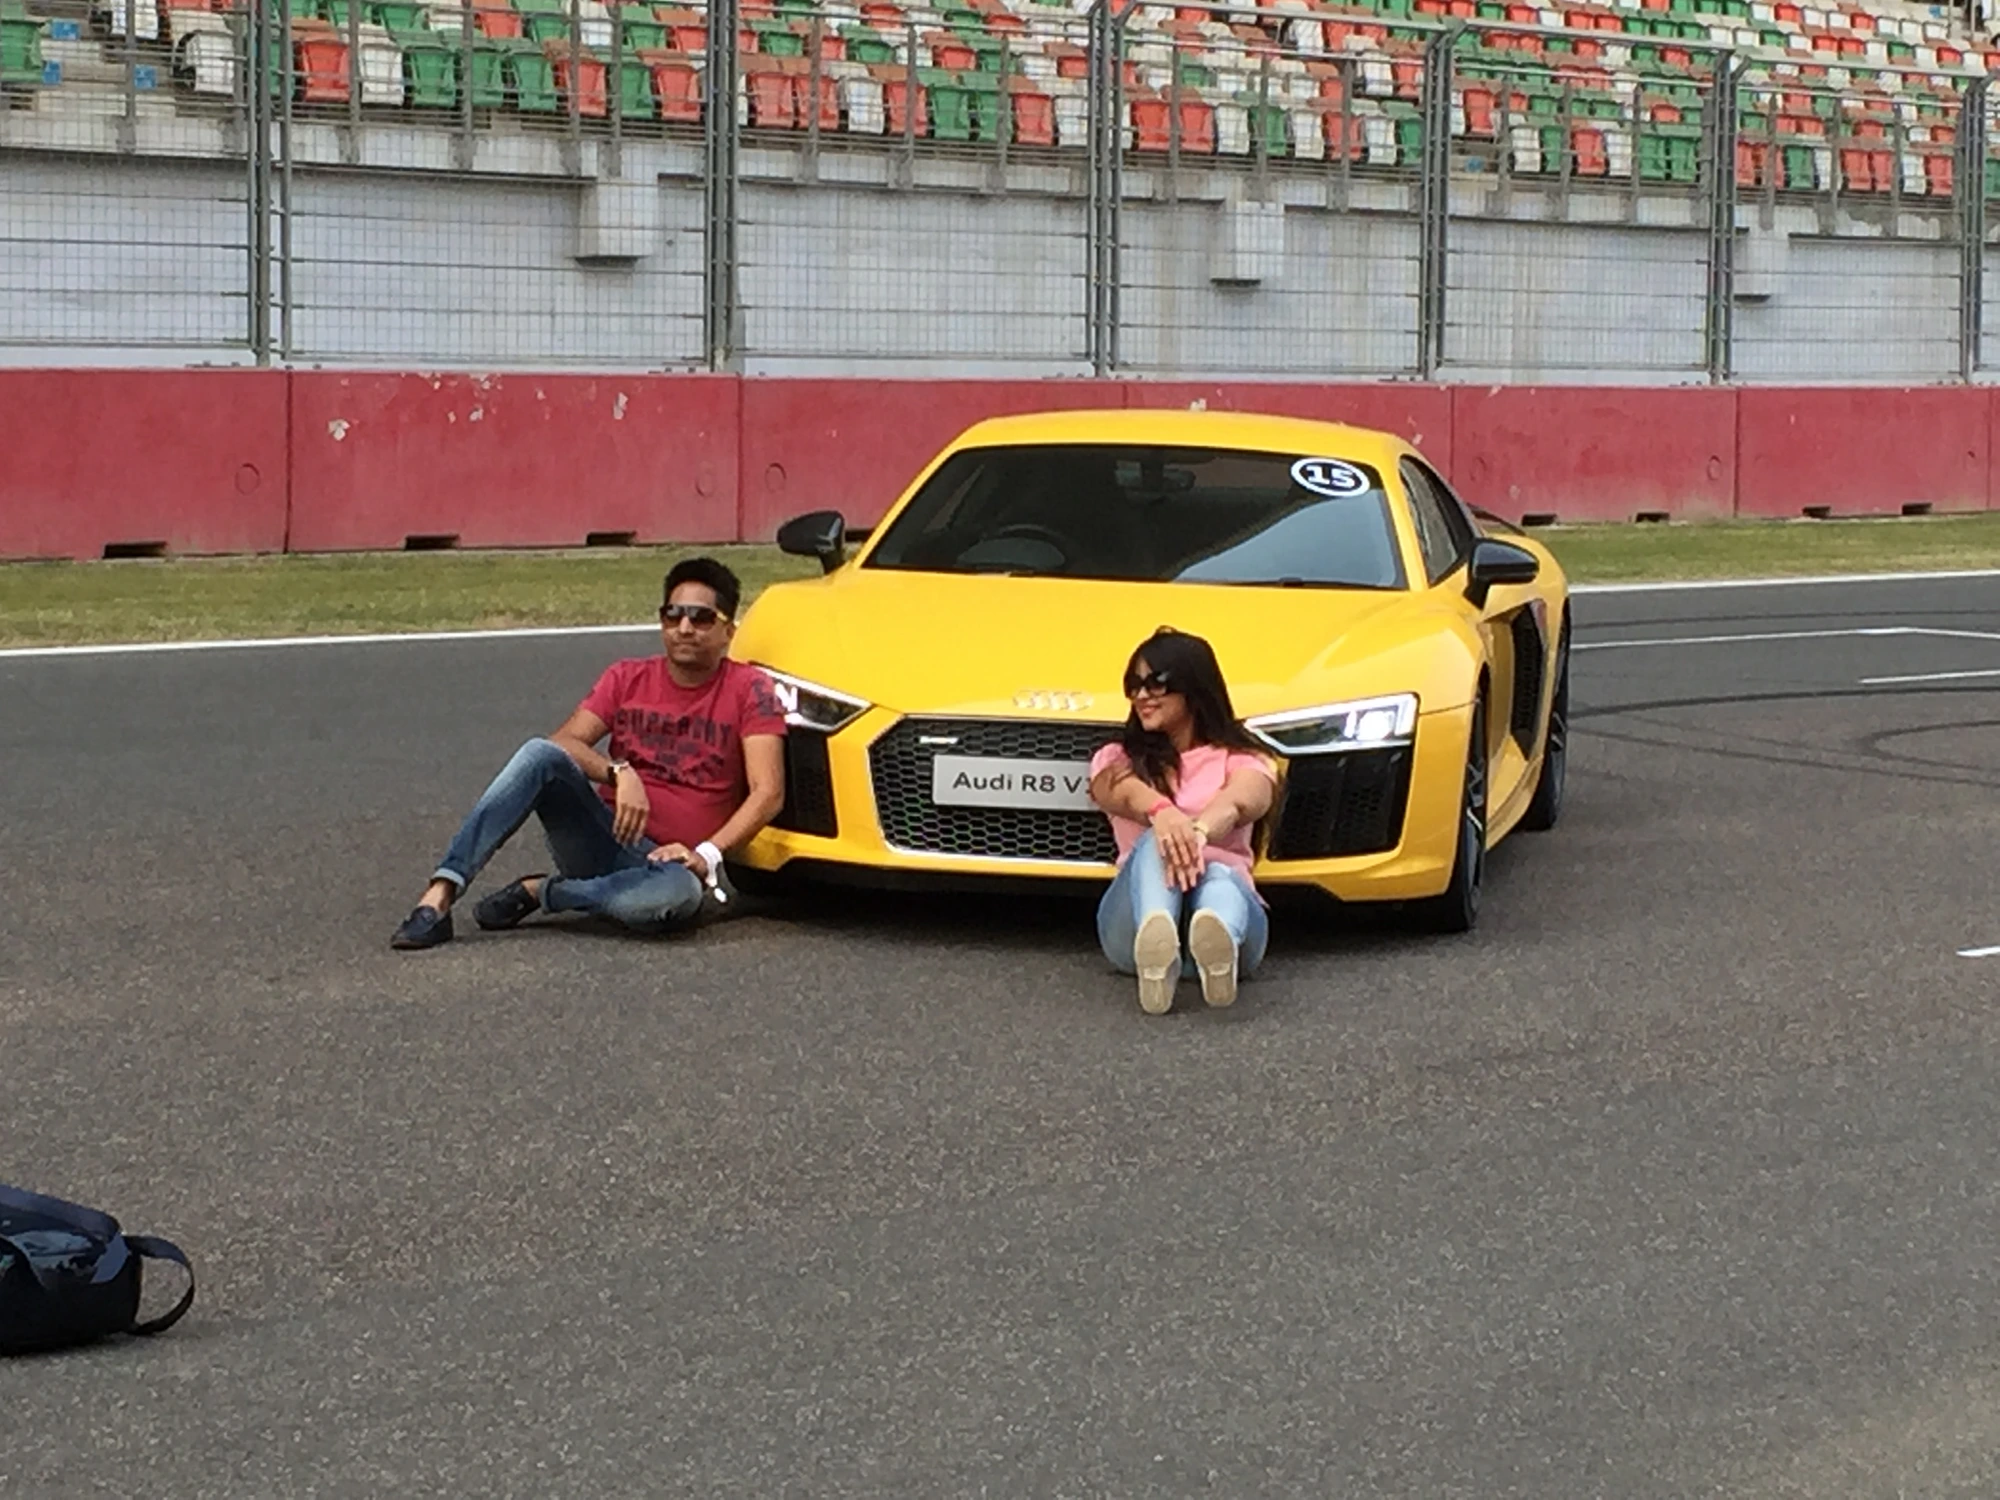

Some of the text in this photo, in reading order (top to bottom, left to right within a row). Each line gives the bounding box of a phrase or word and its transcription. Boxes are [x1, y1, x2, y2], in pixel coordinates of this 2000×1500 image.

[1306, 465, 1355, 488] 15
[953, 772, 1012, 791] Audi
[1022, 774, 1056, 794] R8
